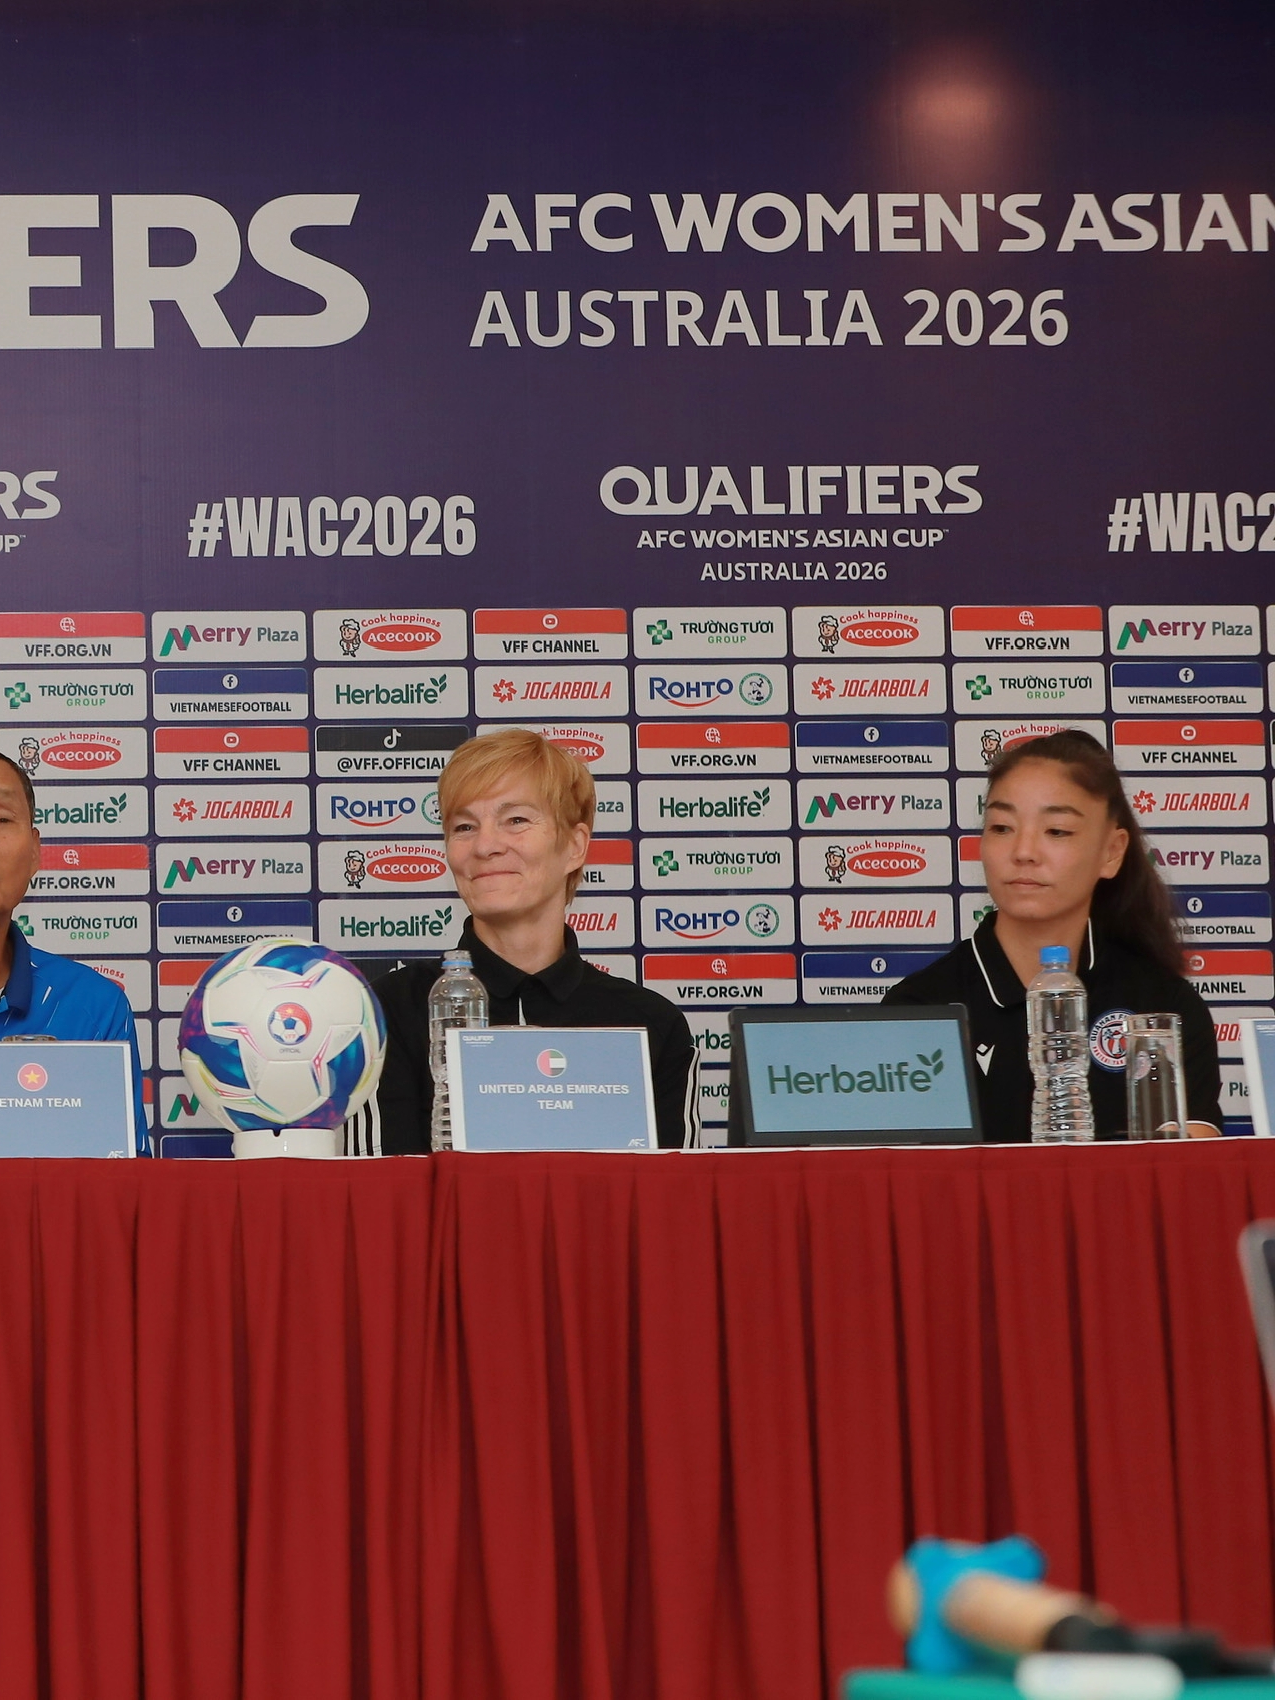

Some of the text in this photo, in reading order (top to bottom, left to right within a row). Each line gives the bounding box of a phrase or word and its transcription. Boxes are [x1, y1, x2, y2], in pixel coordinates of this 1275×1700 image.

[470, 193, 633, 253] AFC
[649, 192, 1047, 253] WOMEN'S
[469, 289, 1068, 347] AUSTRALIA 2026
[599, 464, 983, 516] QUALIFIERS
[187, 495, 477, 559] #WAC2026
[636, 531, 685, 548] AFC
[691, 529, 809, 548] WOMEN'S
[813, 529, 887, 548] ASIAN
[701, 562, 886, 581] AUSTRALIA 2026
[361, 613, 441, 628] Cook happiness
[840, 610, 918, 624] Cook happiness
[680, 619, 773, 635] TRƯỜNG TƯƠI
[1117, 618, 1253, 650] Merry Plaza
[160, 625, 298, 656] Merry Plaza
[503, 640, 599, 653] VFF CHANNEL
[708, 635, 746, 644] GROUP
[985, 637, 1069, 650] VFF.ORG.VN
[25, 644, 111, 656] VFF.ORG.VN
[39, 682, 133, 696] TRƯỜNG TƯƠI
[521, 681, 611, 700] JOGARBOLA
[649, 677, 733, 700] ROHTO
[839, 679, 929, 697] JOGARBOLA
[999, 675, 1092, 691] TRƯỜNG TƯƠI
[335, 683, 438, 705] Herbalife
[1027, 691, 1065, 699] GROUP
[1128, 695, 1246, 705] VIETNAMESEFOOTBALL
[67, 698, 105, 706] GROUP
[170, 702, 291, 712] VIETNAMESEFOOTBALL
[671, 754, 757, 766] VFF.ORG.VN
[813, 754, 932, 765] VIETNAMESEFOOTBALL
[1142, 752, 1237, 763] VFF CHANNEL
[183, 759, 280, 772] VFF CHANNEL
[330, 796, 415, 819] ROHTO
[659, 796, 761, 818] Herbalife
[805, 793, 942, 824] Merry Plaza
[1160, 793, 1249, 811] JOGARBOLA
[201, 801, 293, 819] JOGARBOLA
[847, 840, 925, 855] Cook happiness
[687, 850, 780, 865] TRƯỜNG TƯƠI
[1221, 851, 1261, 865] Plaza
[163, 857, 303, 888] Merry Plaza
[714, 867, 753, 875] GROUP
[42, 914, 137, 930] TRƯỜNG TƯƠI
[340, 915, 443, 937] Herbalife
[655, 909, 740, 931] ROHTO
[846, 911, 936, 928] JOGARBOLA
[70, 931, 109, 940] GROUP
[677, 986, 763, 998] VFF.ORG.VN
[768, 1062, 931, 1095] Herbalife
[479, 1084, 629, 1095] UNITED ARAB EMIRATES
[46, 1098, 81, 1108] TEAM
[538, 1100, 573, 1110] TEAM
[628, 1139, 645, 1147] AFC
